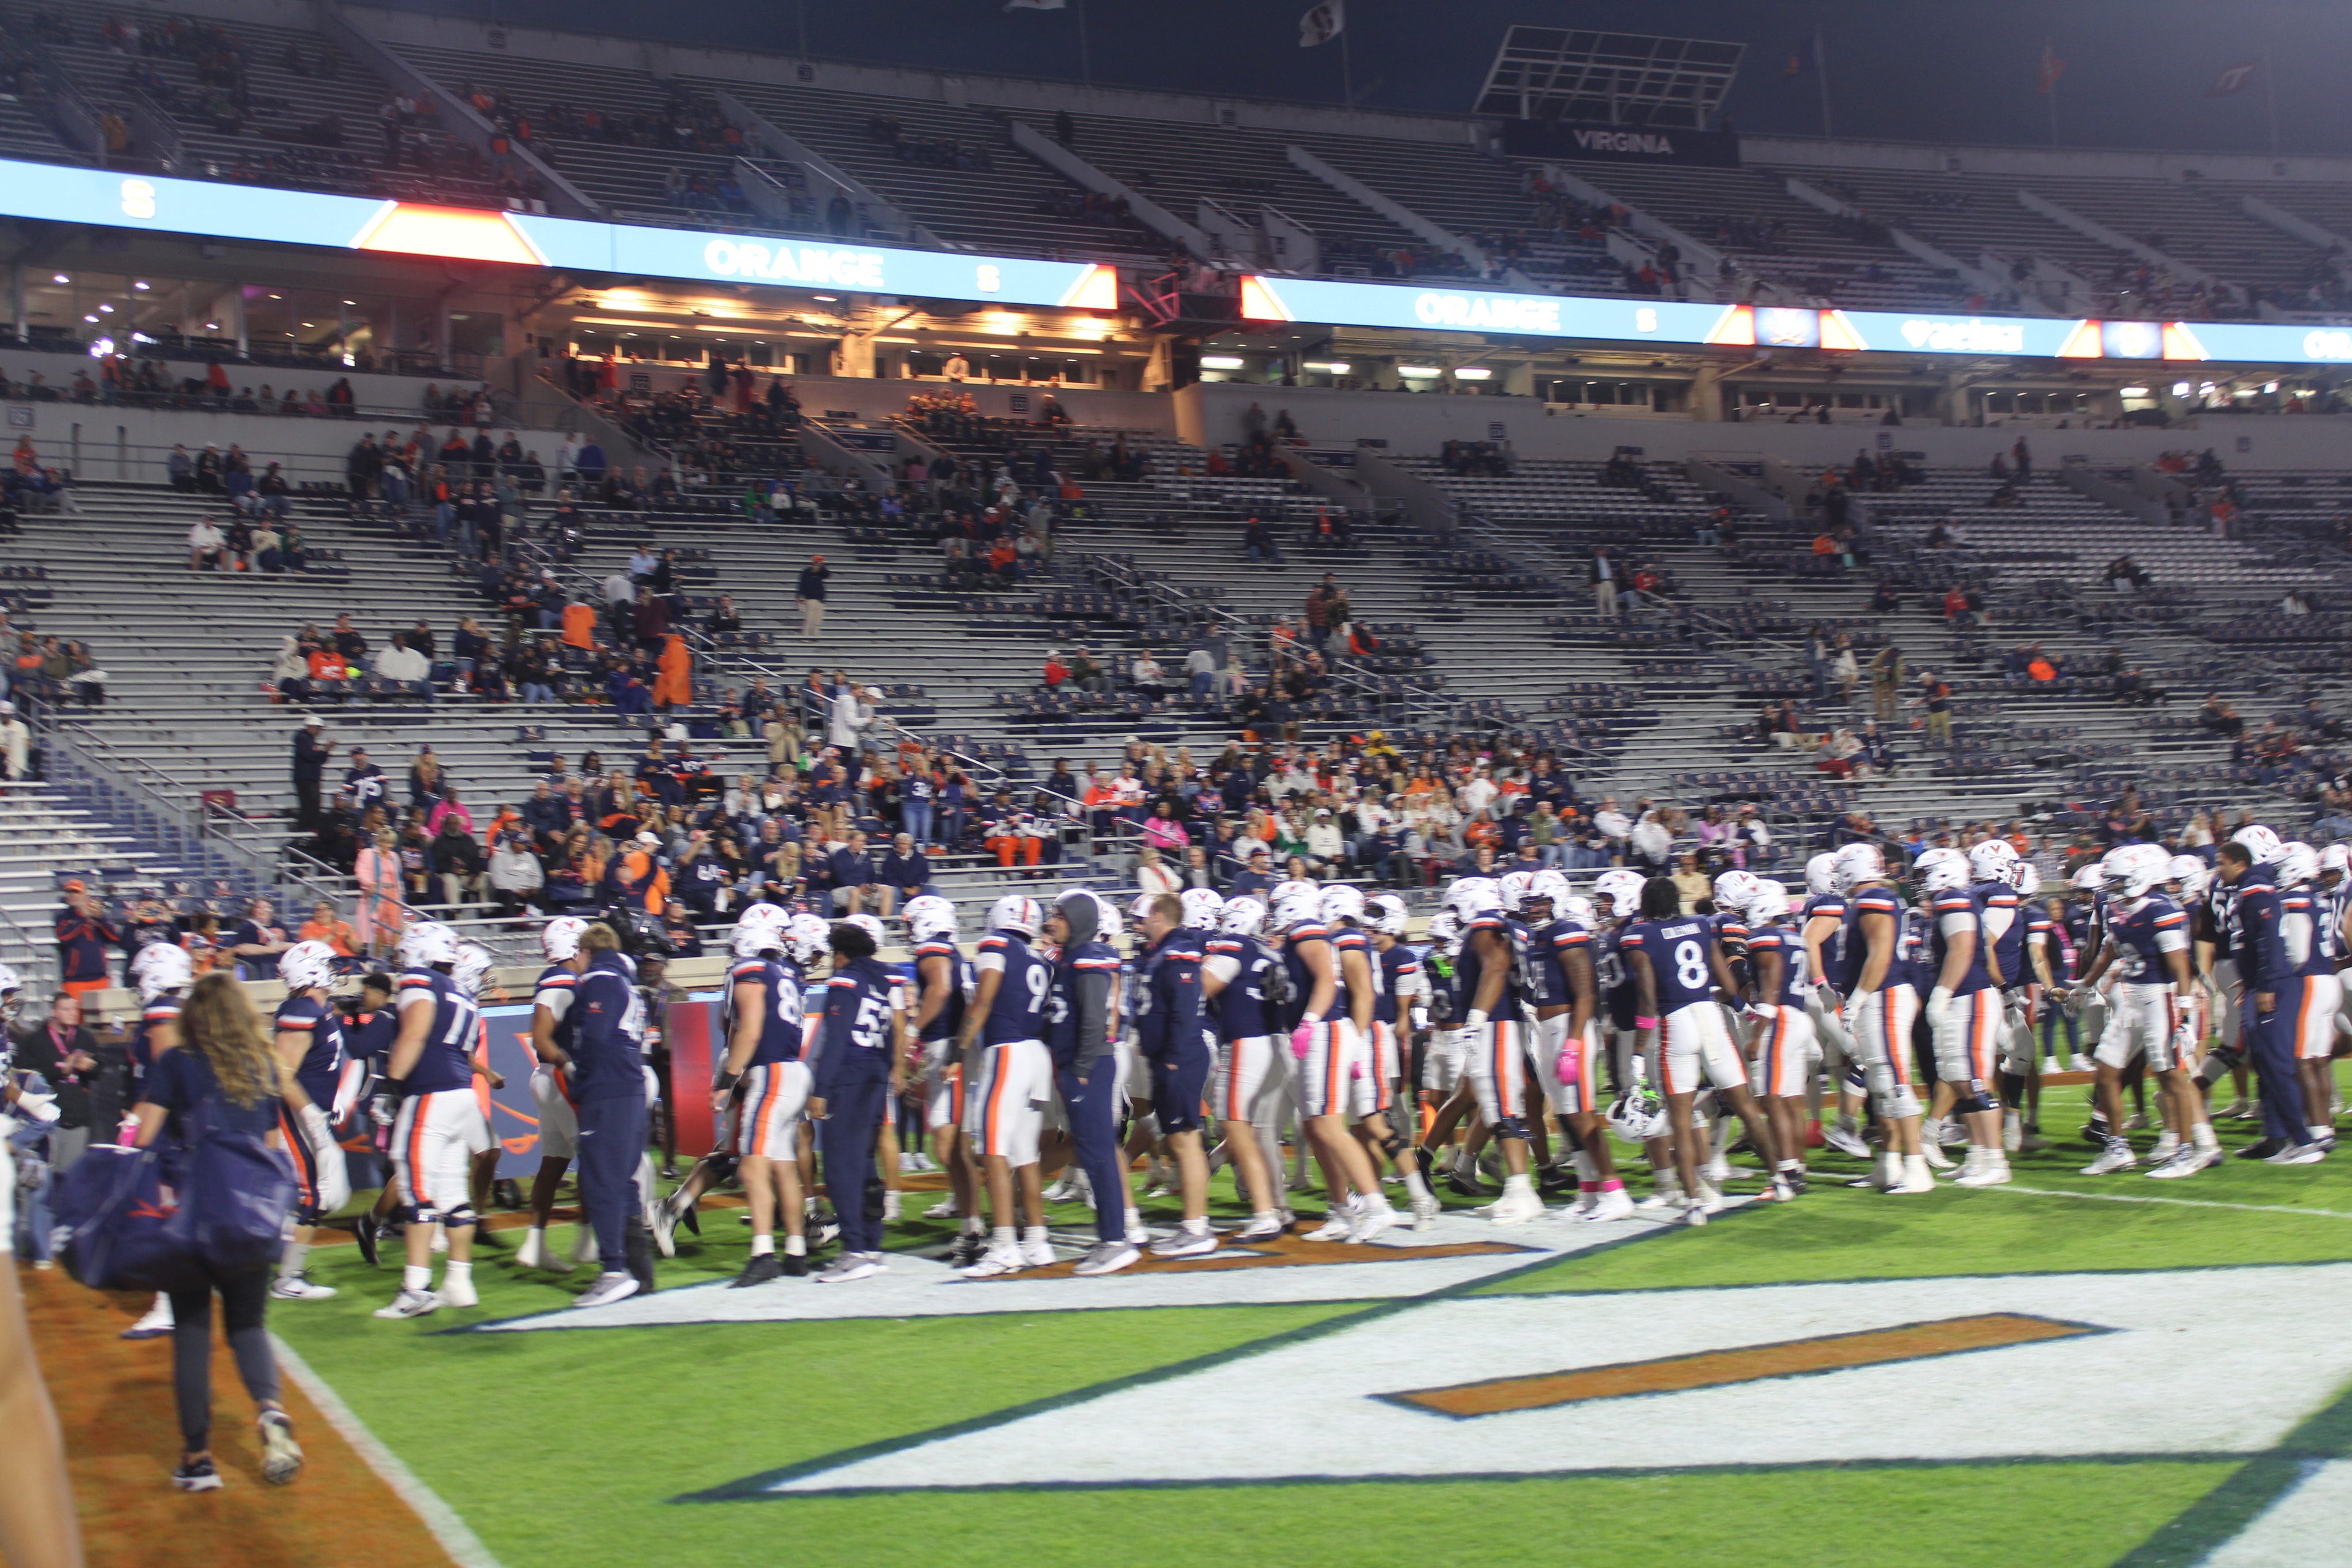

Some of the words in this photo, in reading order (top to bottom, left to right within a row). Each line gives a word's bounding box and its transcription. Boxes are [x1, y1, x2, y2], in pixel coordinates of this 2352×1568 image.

[1572, 129, 1675, 154] VIRGINIA
[704, 239, 884, 287] ORANGE
[1415, 293, 1561, 331] ORANGE
[1675, 940, 1709, 989] 8
